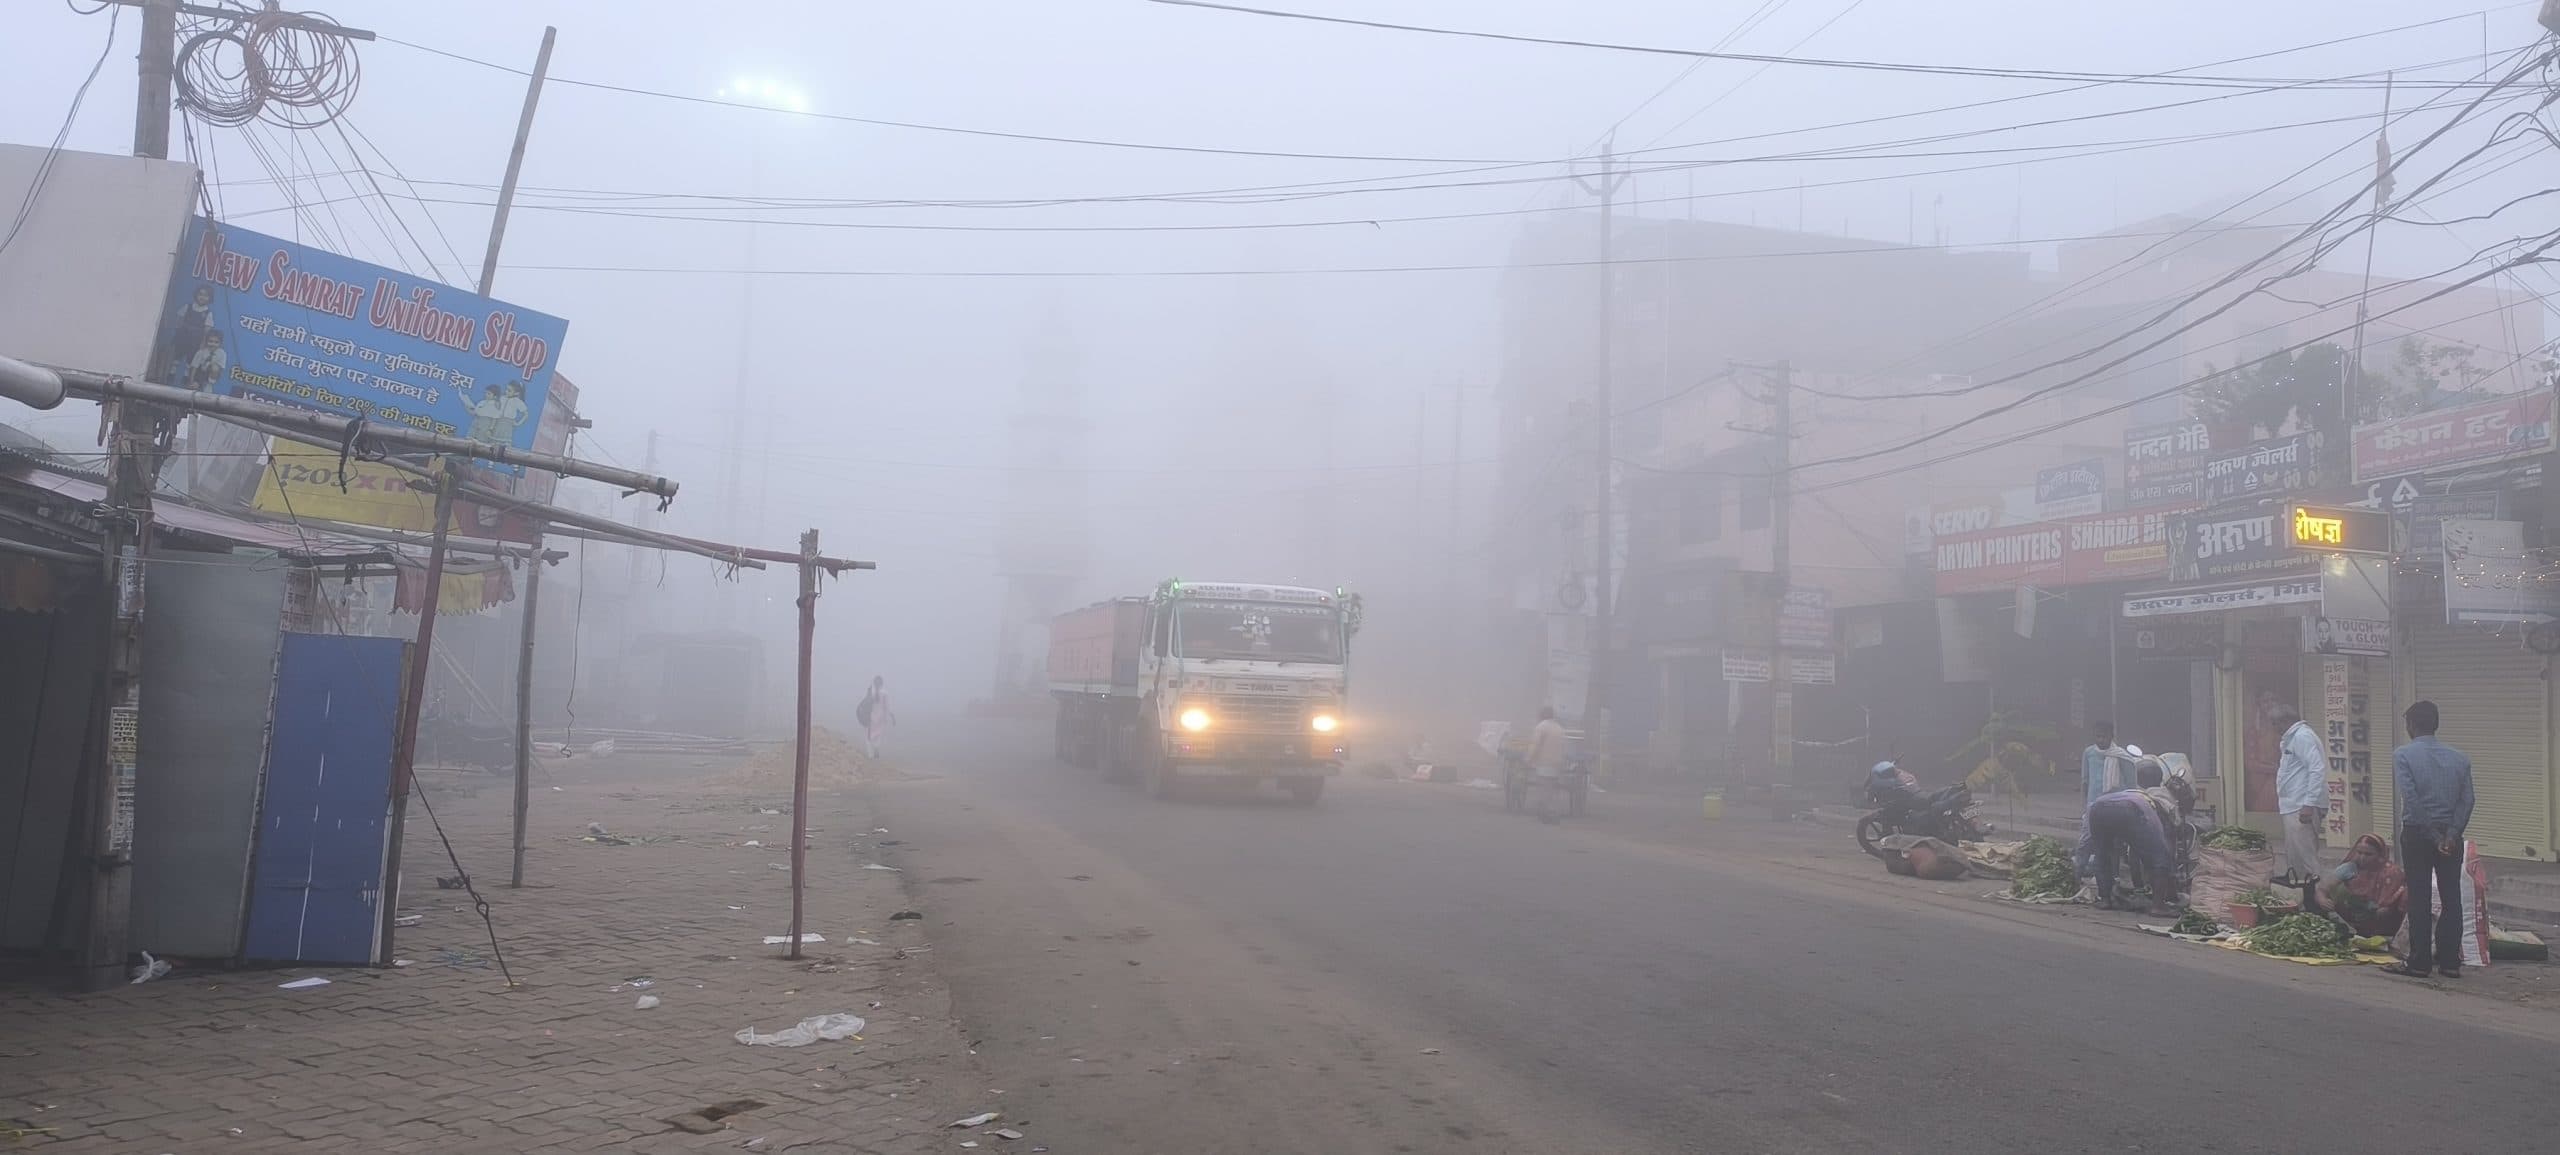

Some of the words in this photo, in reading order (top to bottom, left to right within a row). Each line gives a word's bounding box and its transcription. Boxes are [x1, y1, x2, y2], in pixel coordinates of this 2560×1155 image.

[263, 250, 365, 320] SAMRAT
[240, 315, 273, 334] यहाँ
[273, 324, 307, 344] सभी
[359, 347, 382, 363] का
[264, 347, 307, 370] उचित
[346, 369, 370, 385] पर
[370, 375, 424, 401] उपलब्ध
[426, 387, 440, 405] है
[296, 384, 313, 399] के
[315, 389, 344, 408] लिए
[380, 407, 400, 422] की
[402, 413, 432, 430] भारी
[2128, 436, 2173, 460] नन्दन
[2178, 424, 2210, 451] मेडि
[2207, 454, 2247, 480] अरुण
[2251, 439, 2298, 468] ज्वेलर्स
[2167, 482, 2193, 497] नन्दन
[1934, 509, 1992, 536] SERVO
[2071, 516, 2140, 550] SHARDA
[2197, 516, 2274, 559] अरुण
[1937, 538, 1983, 572] ARYAN
[1986, 529, 2062, 567] PRINTERS
[2129, 598, 2184, 612] अरुण
[2335, 619, 2374, 634] TOUCH
[2355, 631, 2389, 645] GLOW
[2327, 720, 2347, 775] अरुण
